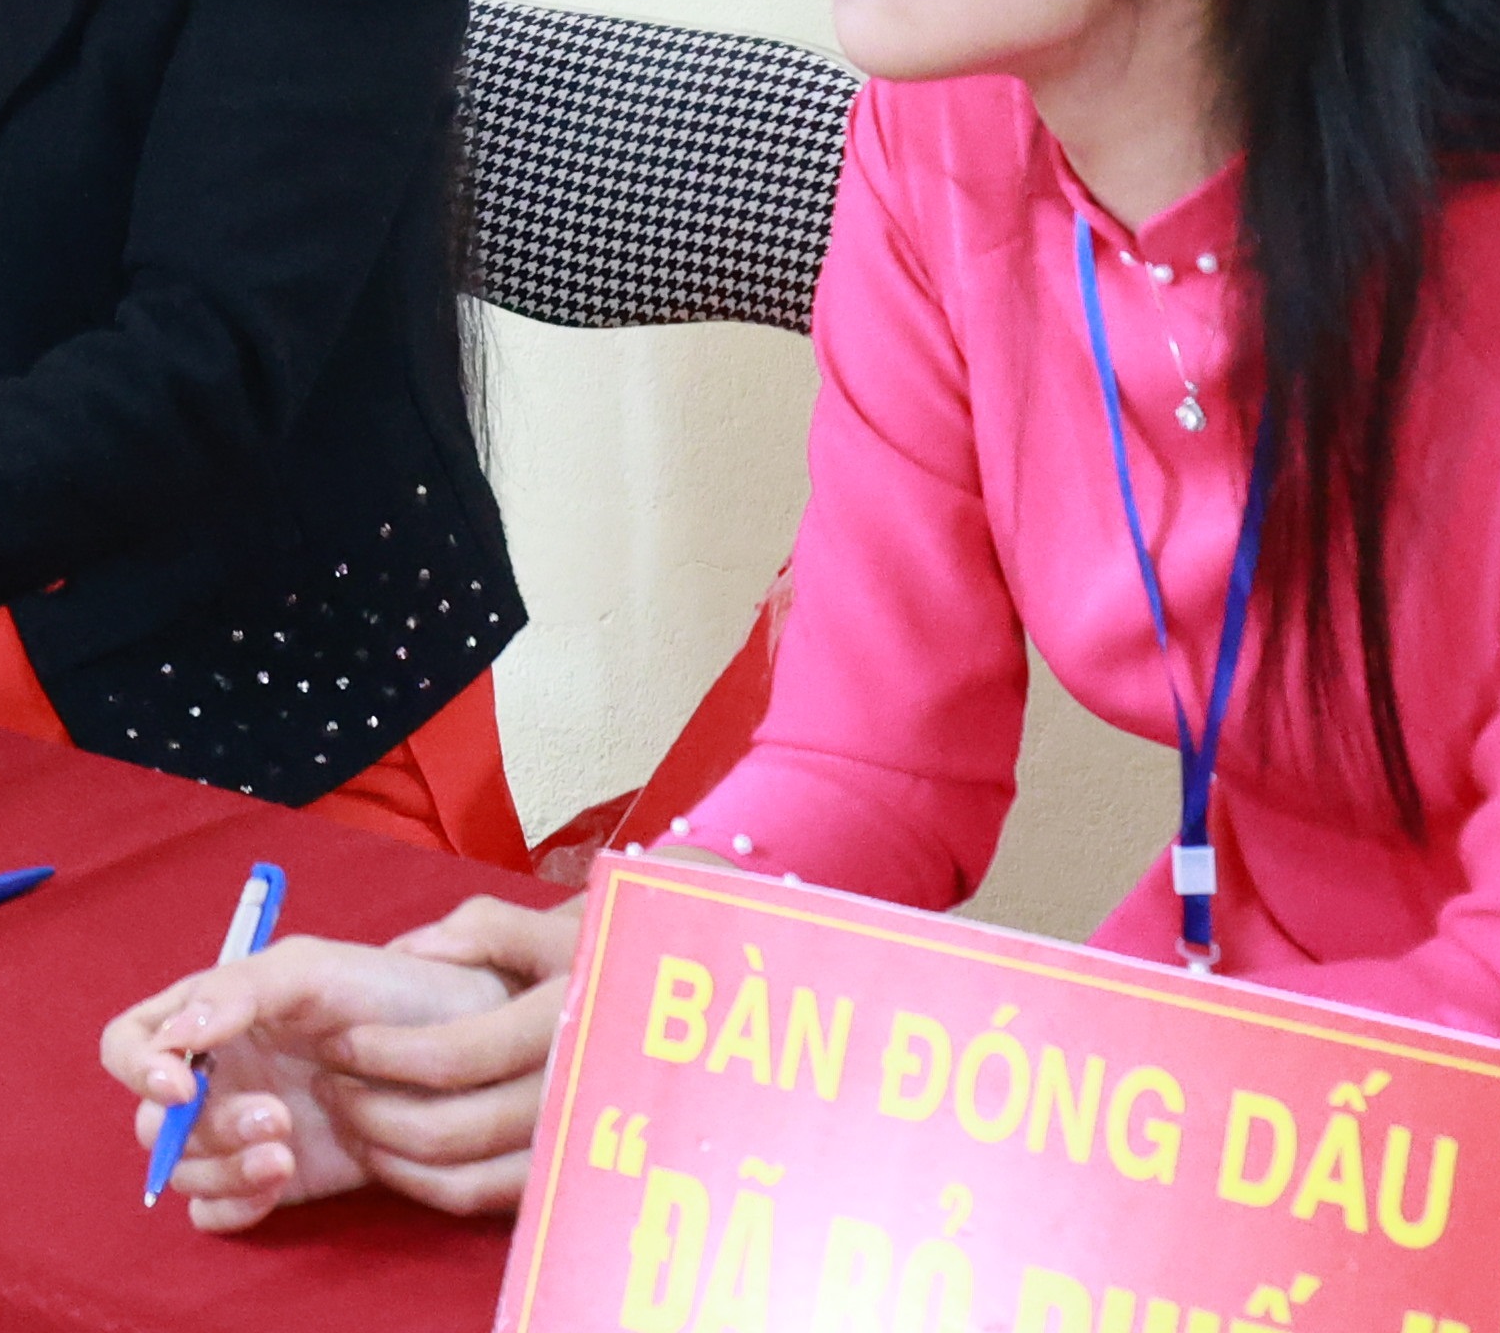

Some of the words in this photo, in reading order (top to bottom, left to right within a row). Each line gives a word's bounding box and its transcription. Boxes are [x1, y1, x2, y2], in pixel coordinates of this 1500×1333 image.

[644, 946, 853, 1100] BÀN
[880, 1006, 1185, 1184] ĐÓNG
[1219, 1071, 1459, 1250] DẤU
